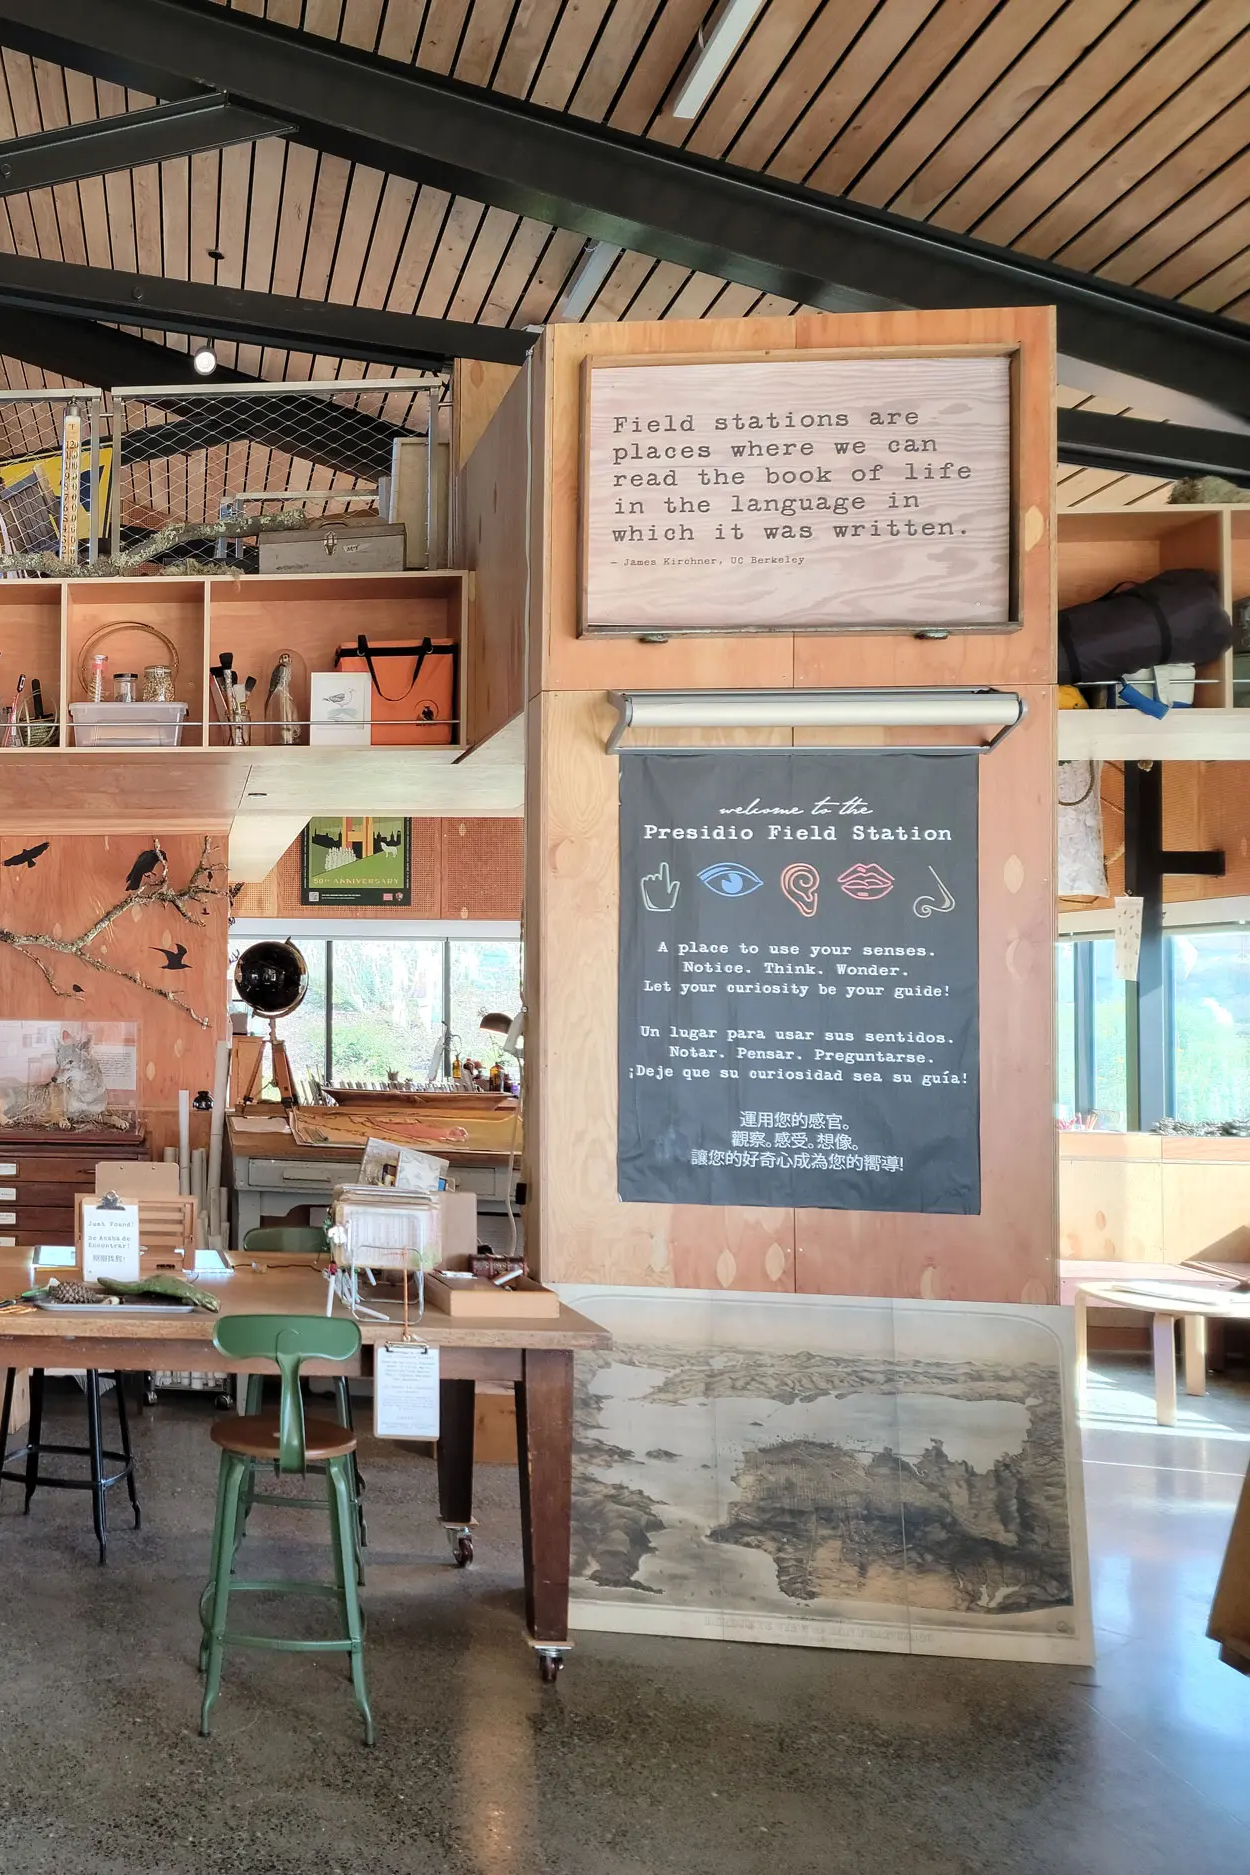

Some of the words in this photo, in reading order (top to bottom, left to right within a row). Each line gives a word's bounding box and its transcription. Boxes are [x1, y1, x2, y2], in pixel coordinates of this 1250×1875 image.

[613, 414, 695, 434] Field
[714, 411, 850, 431] stations
[869, 410, 920, 426] are
[65, 440, 79, 450] 120
[612, 442, 712, 466] places
[730, 440, 815, 457] where
[833, 439, 867, 455] we
[887, 437, 938, 453] can
[613, 469, 679, 487] read
[697, 468, 746, 486] the
[765, 466, 833, 484] book
[851, 464, 884, 482] of
[904, 462, 972, 480] life
[63, 493, 77, 502] 70
[614, 498, 645, 515] in
[663, 496, 711, 514] the
[730, 495, 867, 516] language
[887, 491, 920, 509] in
[611, 524, 695, 542] which
[714, 523, 744, 541] it
[763, 524, 813, 539] was
[832, 519, 967, 538] written.
[623, 557, 657, 566] James
[663, 556, 724, 567] Kirchner,
[730, 556, 744, 565] UC
[718, 798, 805, 816] welcome
[811, 796, 841, 816] to
[839, 796, 874, 816] the
[643, 824, 754, 841] Presidio
[767, 825, 838, 841] Field
[852, 825, 952, 842] Station
[657, 941, 669, 953] A
[677, 941, 729, 957] place
[738, 943, 760, 955] to
[768, 944, 801, 955] use
[810, 945, 853, 958] your
[862, 945, 936, 957] senses.
[682, 961, 752, 974] Notice.
[763, 962, 824, 975] Think.
[836, 963, 909, 977] Wonder.
[643, 980, 672, 992] Let
[680, 982, 717, 995] your
[726, 982, 809, 998] curiosity
[818, 983, 838, 995] be
[846, 985, 885, 998] your
[894, 985, 951, 999] guide!
[639, 1025, 660, 1038] Un
[669, 1026, 718, 1040] lugar
[726, 1029, 766, 1042] para
[775, 1030, 815, 1041] usar
[824, 1030, 855, 1042] sus
[864, 1030, 954, 1044] sentidos.
[669, 1045, 725, 1058] Notar.
[736, 1046, 803, 1060] Pensar.
[813, 1048, 935, 1065] Preguntarse.
[628, 1064, 674, 1080] ¡Deje
[682, 1067, 715, 1081] que
[719, 1068, 739, 1080] su
[748, 1068, 844, 1082] curiosidad
[853, 1071, 883, 1083] sea
[892, 1072, 913, 1084] su
[921, 1070, 968, 1088] guía!
[738, 1111, 851, 1131] 運用您的感官。
[730, 1130, 860, 1151] 觀察。感受。想像。
[88, 1220, 106, 1228] Just
[109, 1220, 134, 1229] Found!
